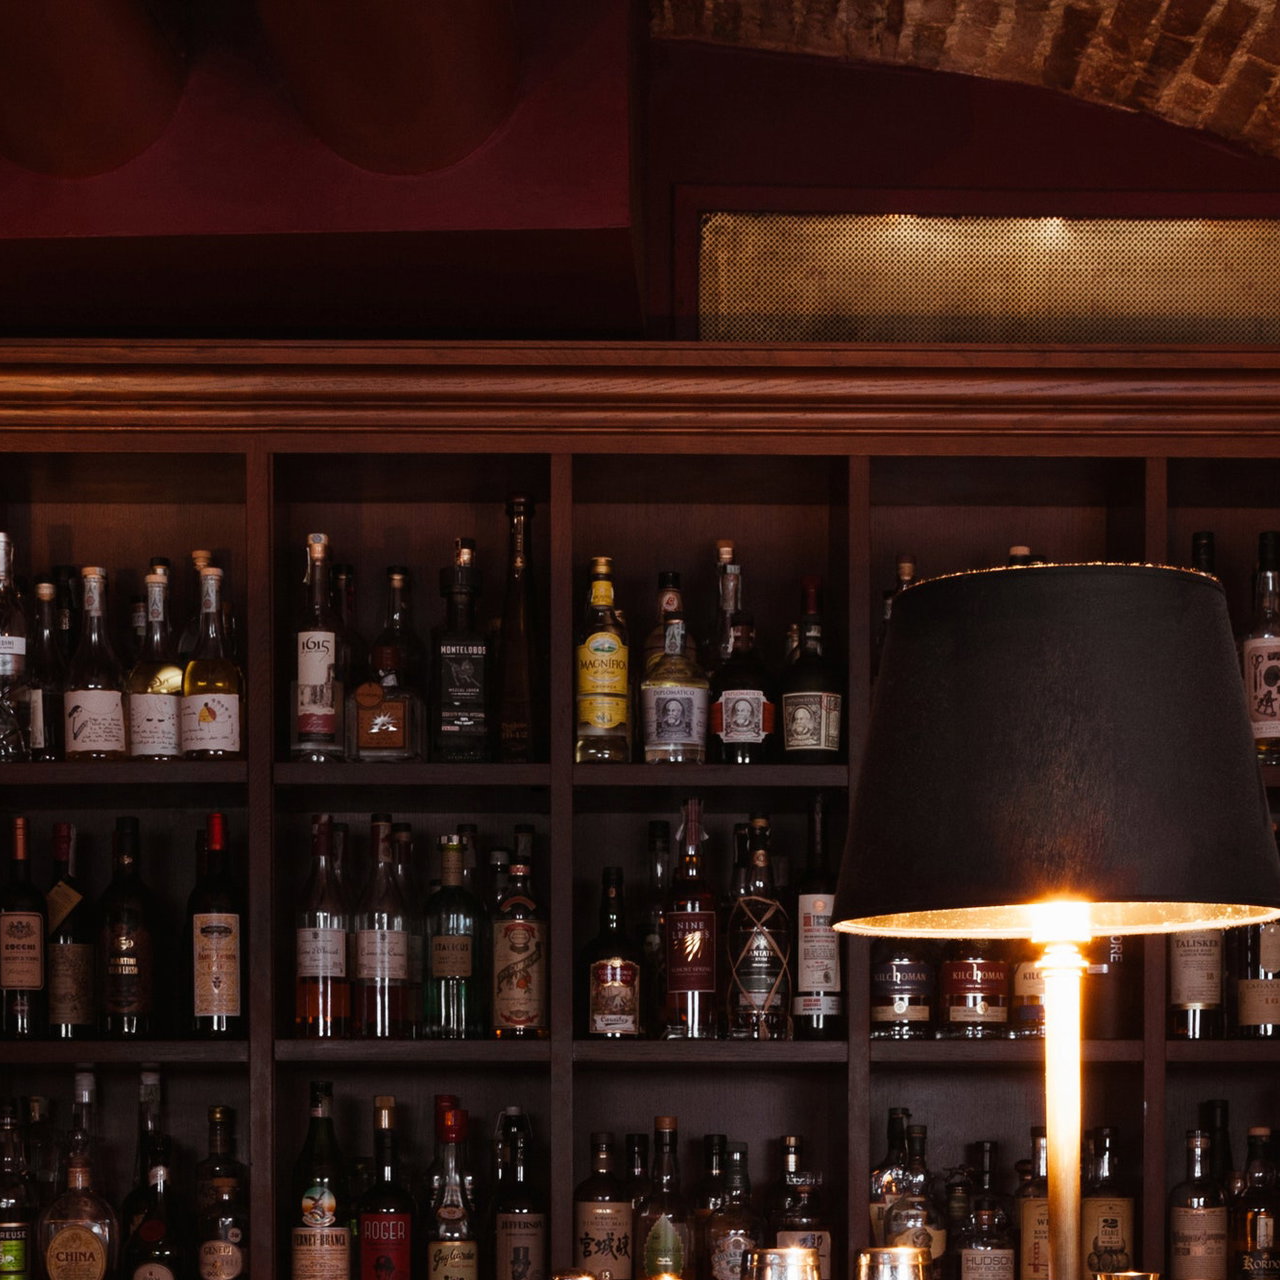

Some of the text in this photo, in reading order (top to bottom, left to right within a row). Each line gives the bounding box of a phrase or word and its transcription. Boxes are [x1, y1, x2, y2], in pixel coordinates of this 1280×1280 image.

[302, 637, 331, 654] 1615
[440, 646, 486, 655] MONTELOBOS
[1110, 936, 1123, 963] ORE
[952, 963, 1005, 983] KILCHOMAN
[365, 1221, 405, 1240] ROGER
[56, 1252, 96, 1262] CHINA
[966, 1257, 1013, 1265] HUDSON
